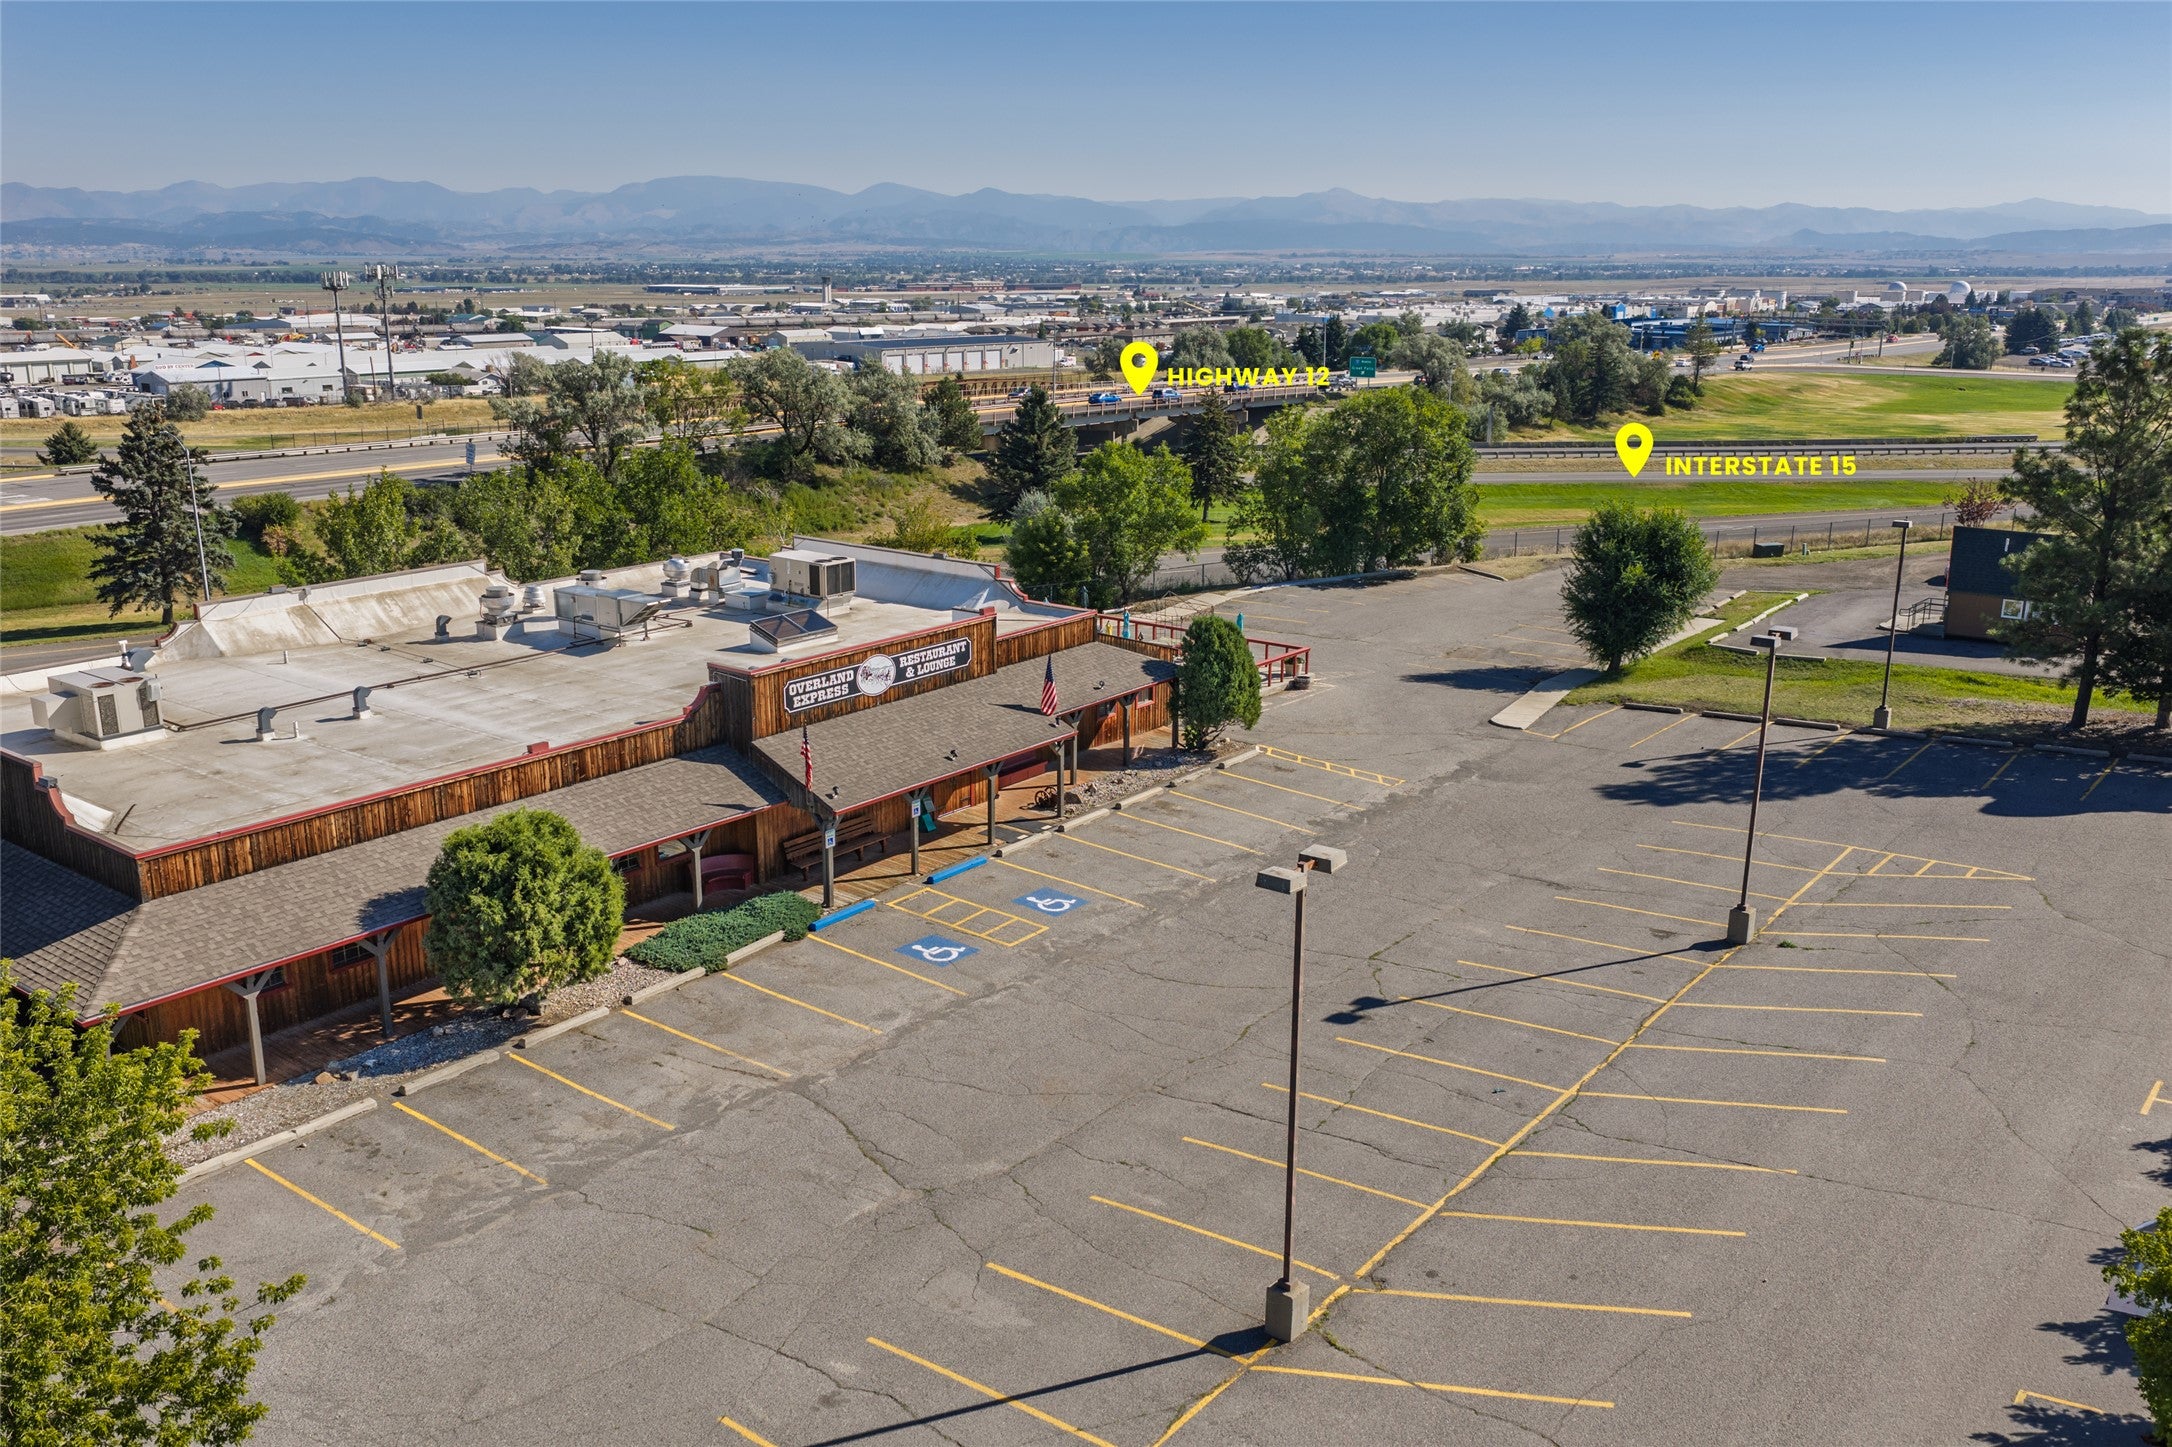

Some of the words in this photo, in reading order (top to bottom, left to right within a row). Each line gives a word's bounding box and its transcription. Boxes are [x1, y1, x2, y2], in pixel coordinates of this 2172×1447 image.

[899, 640, 967, 668] RESTAURANT
[905, 666, 915, 678] &
[917, 655, 956, 675] LOUNGE
[788, 670, 855, 696] OVERLAND
[792, 684, 849, 708] EXPRESS
